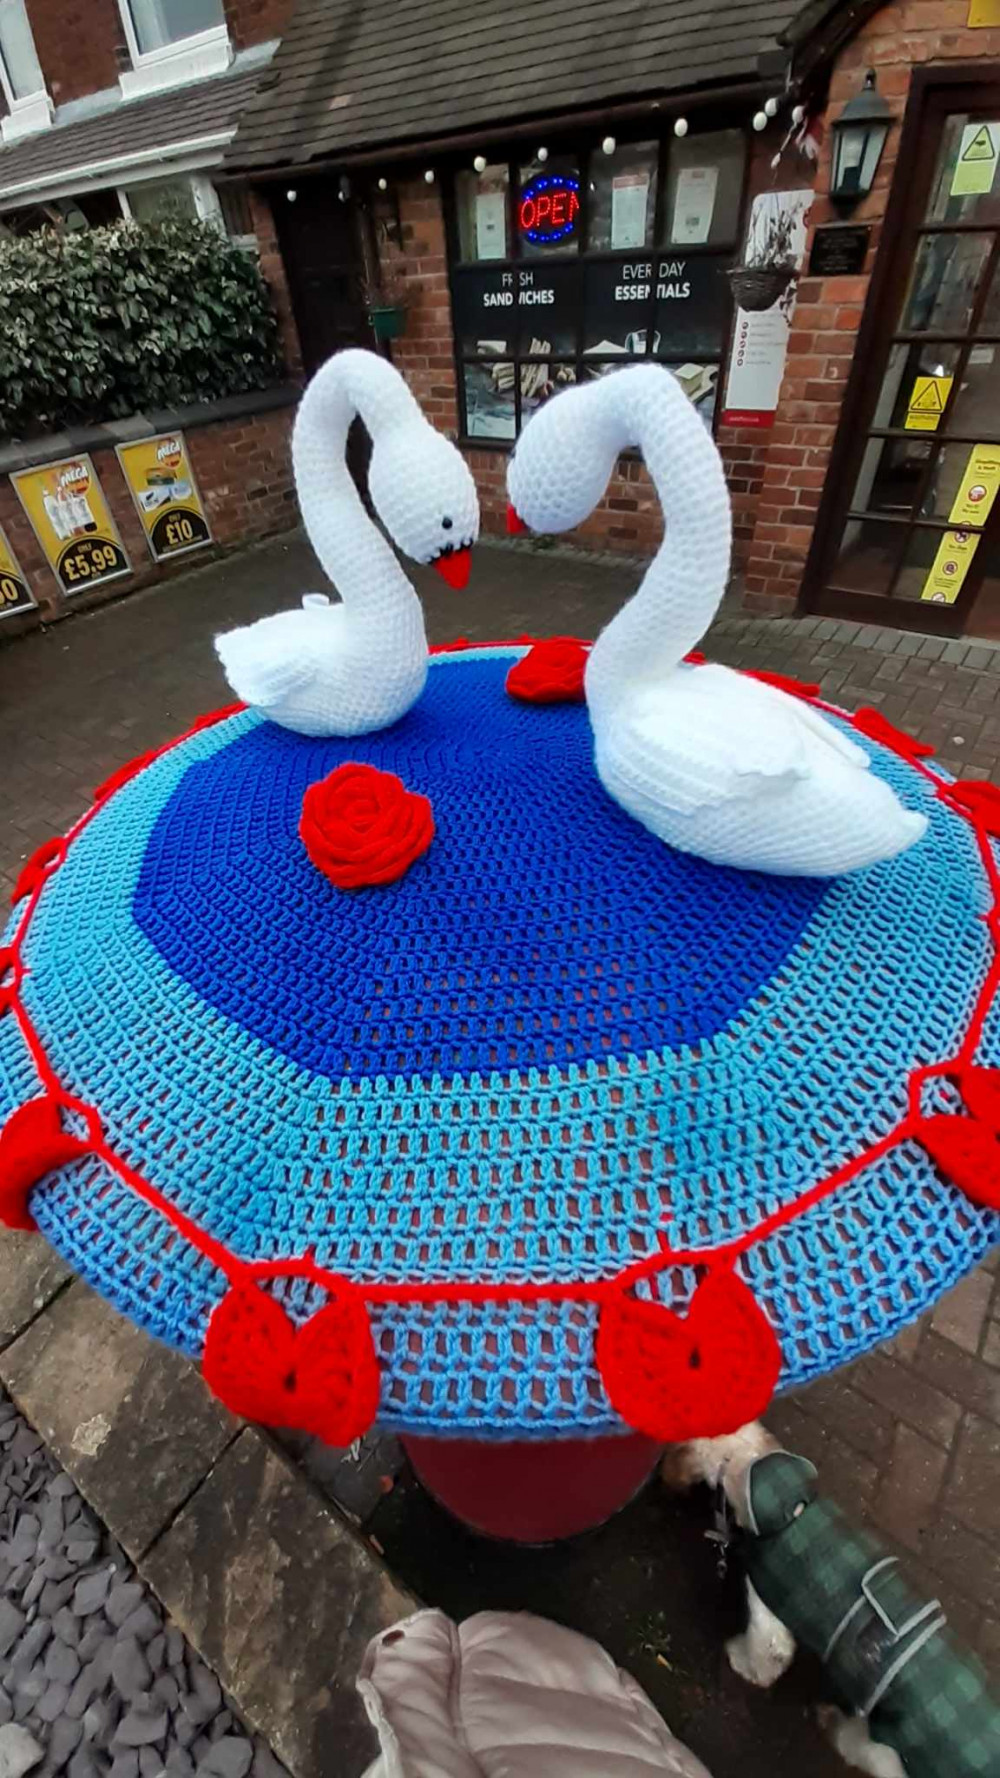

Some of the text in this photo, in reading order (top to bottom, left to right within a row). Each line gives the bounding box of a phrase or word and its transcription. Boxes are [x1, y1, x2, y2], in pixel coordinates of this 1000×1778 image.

[483, 289, 555, 307] SANDICHES
[166, 519, 193, 545] £10
[64, 545, 117, 581] £5.99
